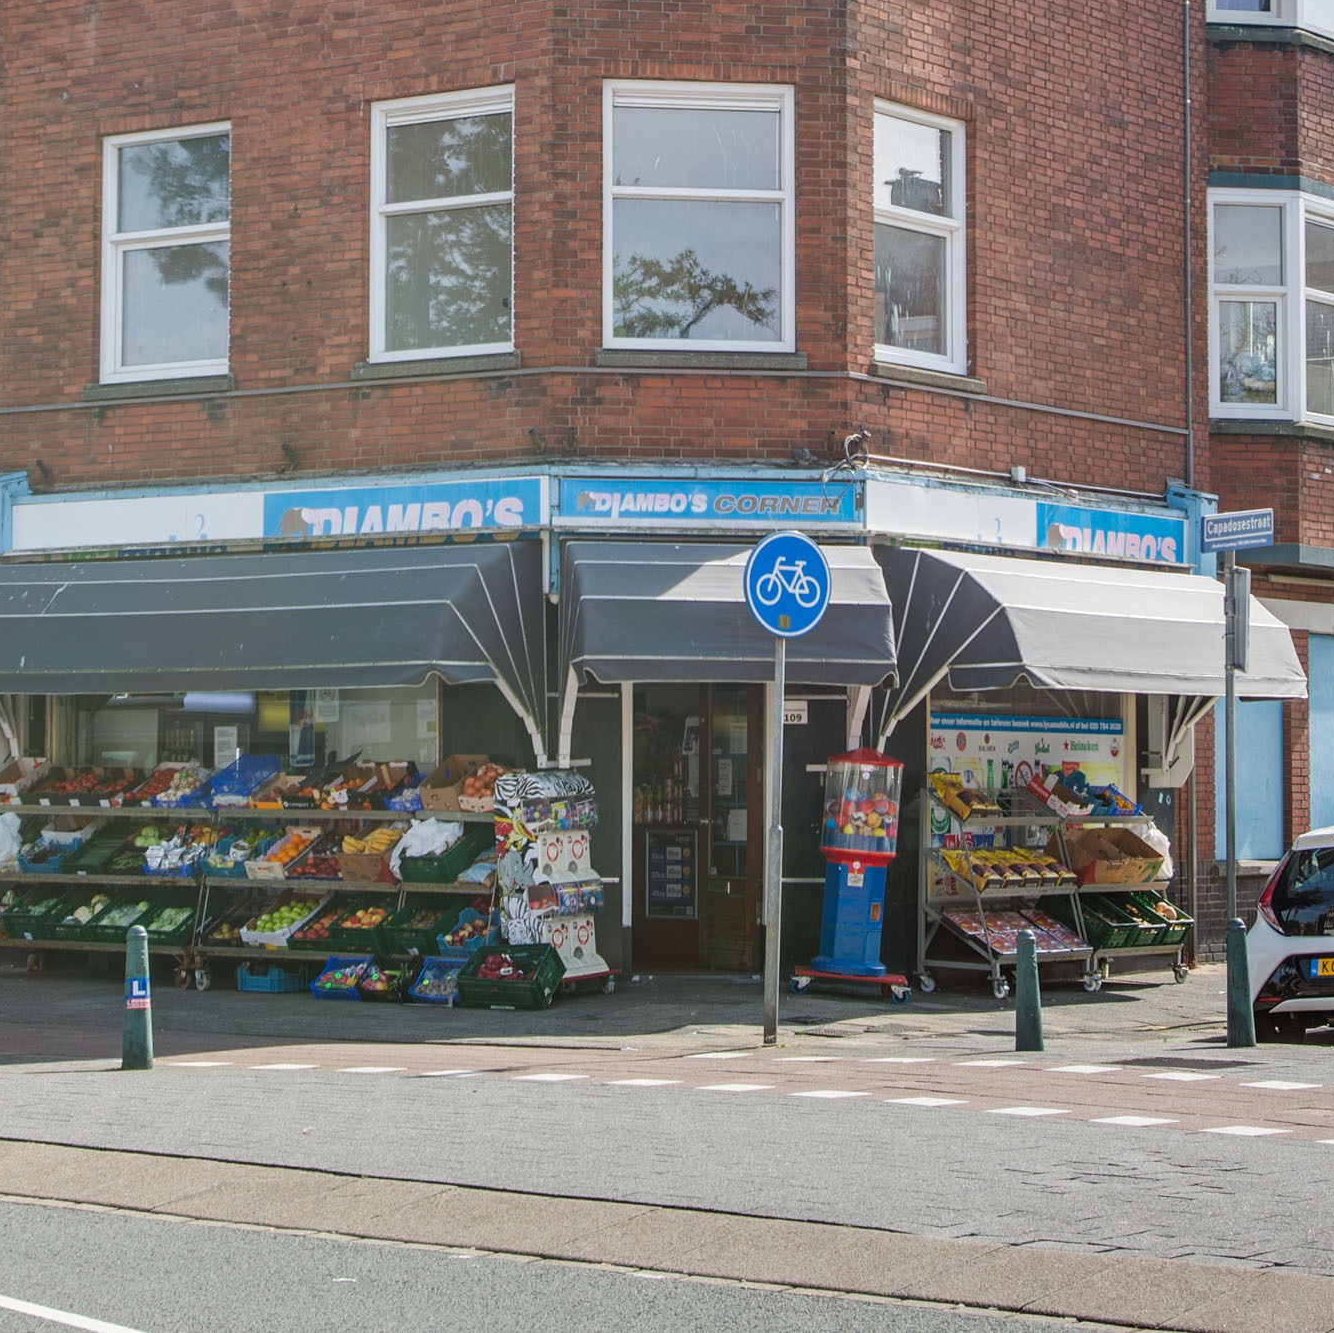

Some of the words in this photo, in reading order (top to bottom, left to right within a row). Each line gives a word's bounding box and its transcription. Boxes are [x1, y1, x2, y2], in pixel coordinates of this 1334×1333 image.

[594, 492, 707, 517] DJAMBO'S
[714, 495, 840, 514] CORNER
[1207, 515, 1271, 536] Capadosestraat
[784, 713, 802, 723] 109
[1070, 740, 1099, 751] Heineken
[132, 980, 146, 996] L
